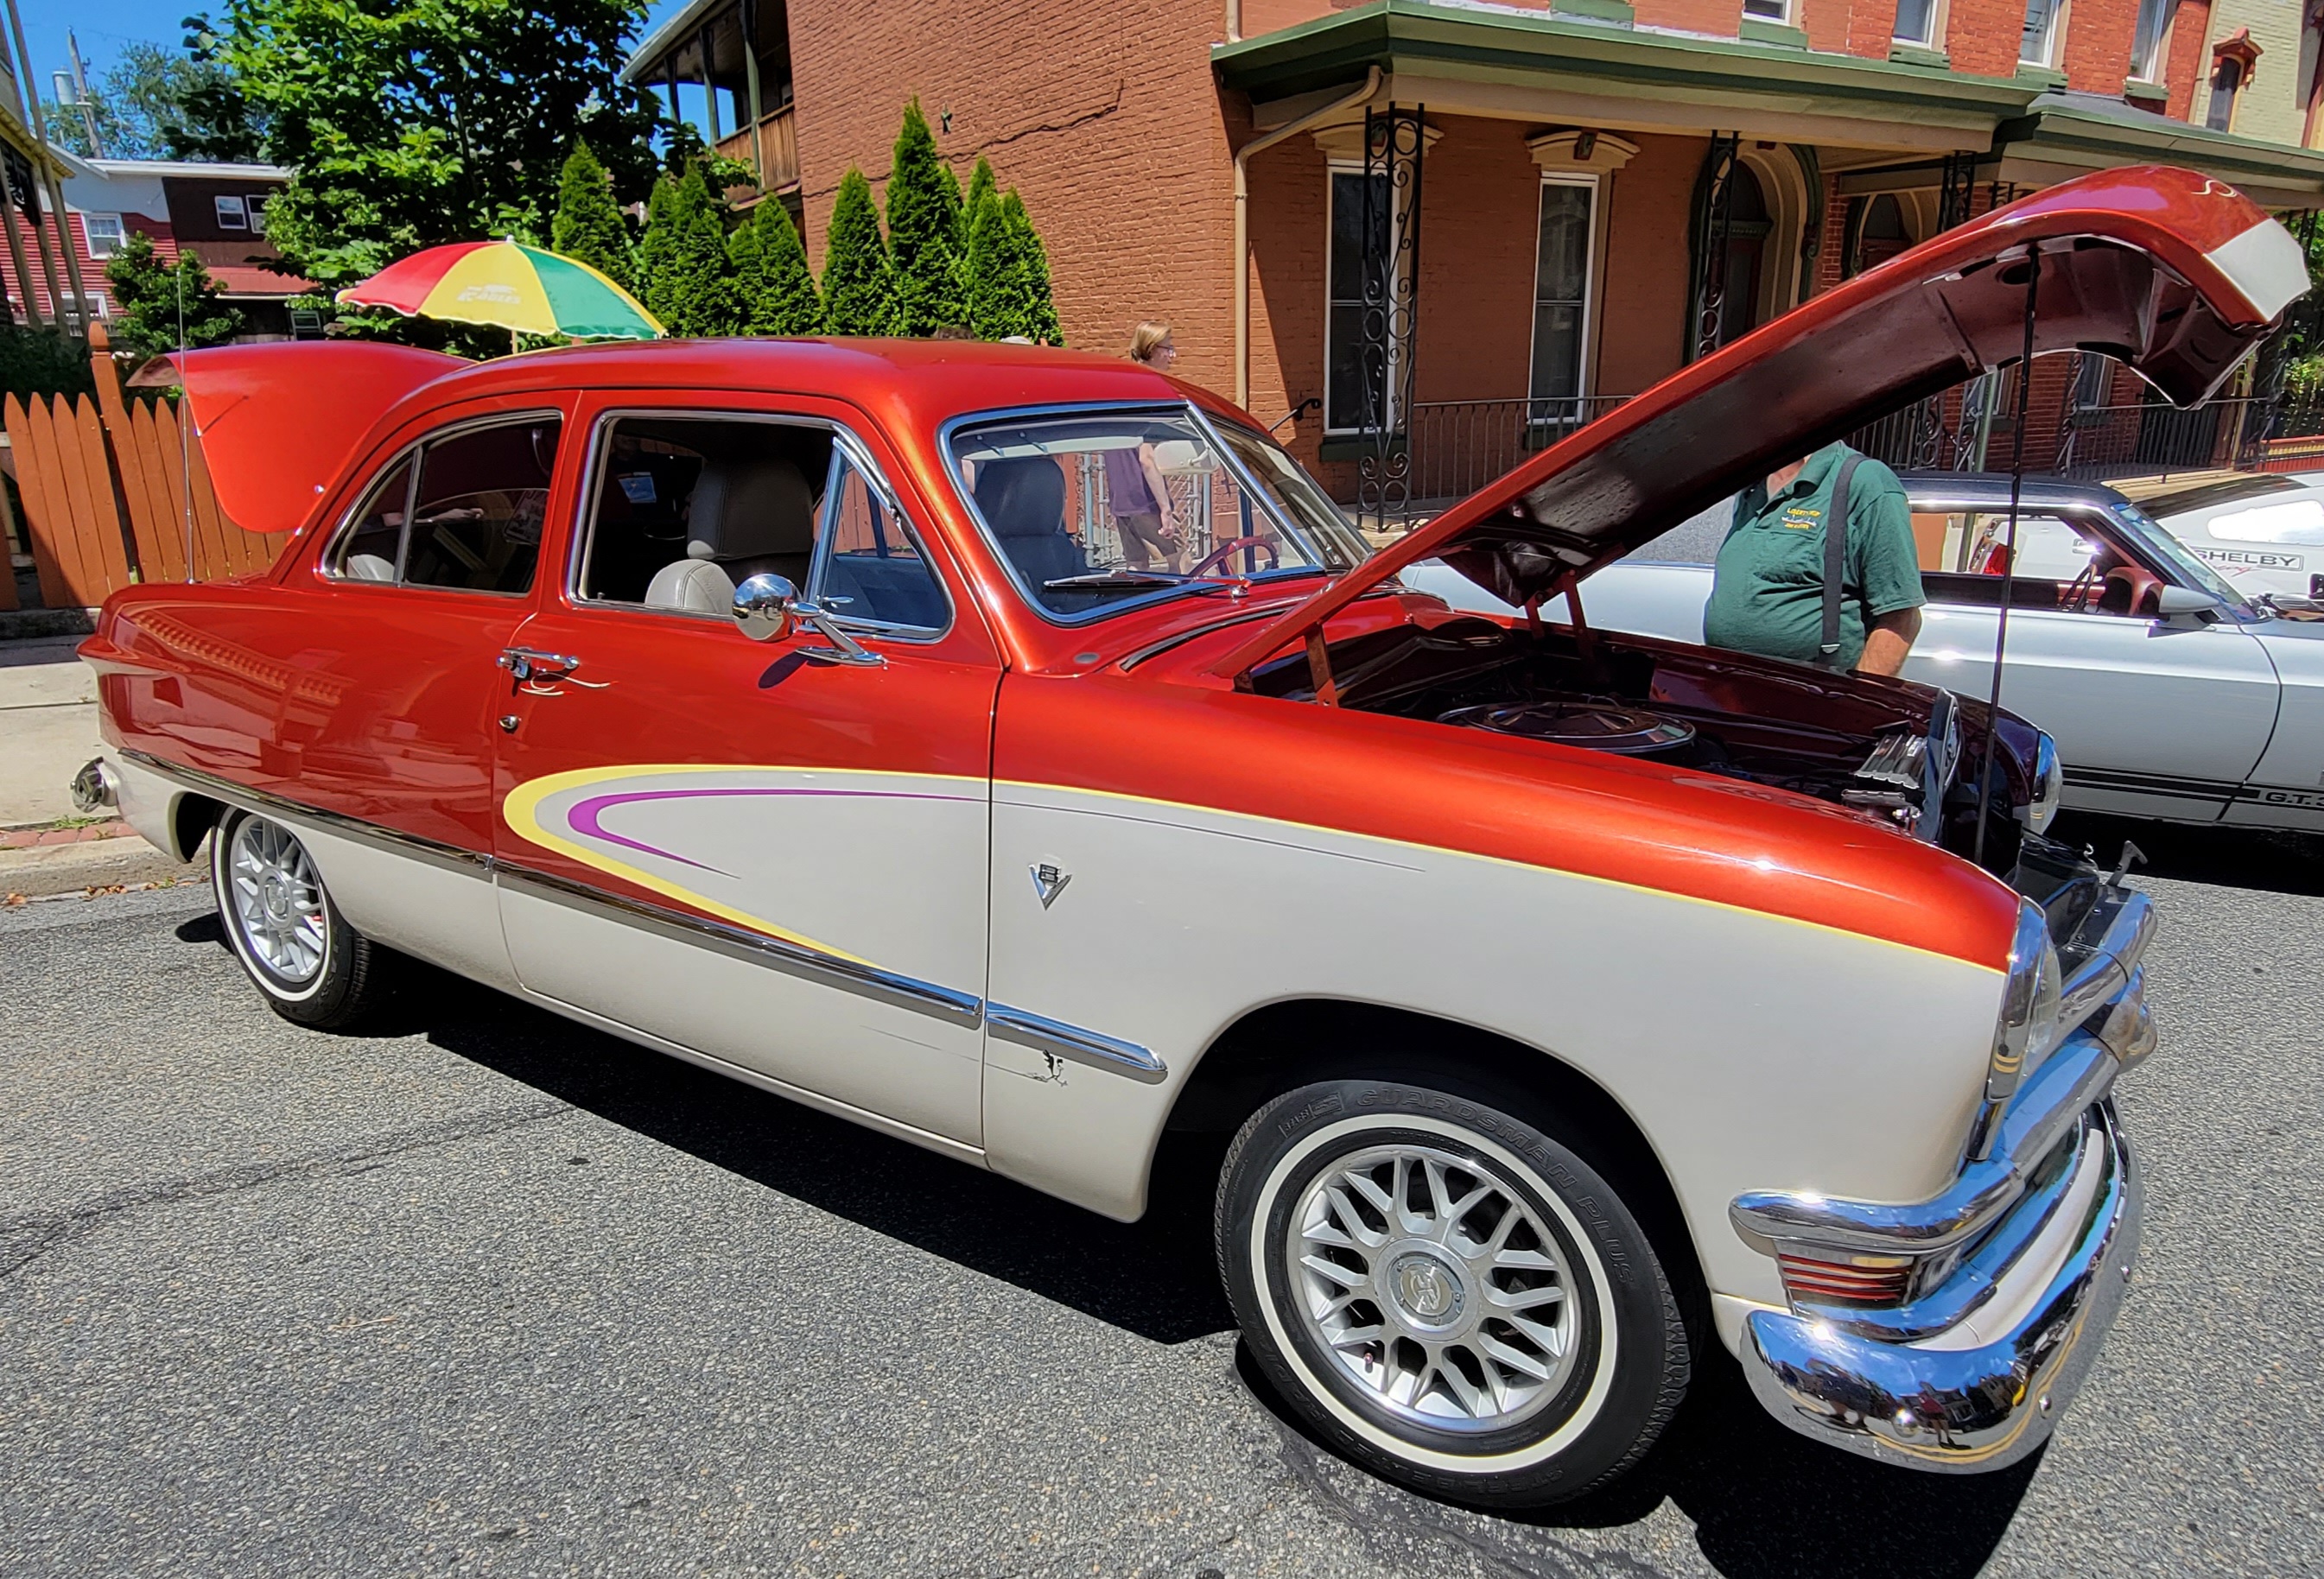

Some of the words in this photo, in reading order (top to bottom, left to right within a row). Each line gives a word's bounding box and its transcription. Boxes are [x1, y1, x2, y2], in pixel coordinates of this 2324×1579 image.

[2195, 549, 2296, 567] SHELBY
[1356, 1088, 1578, 1189] GUARDSMAN
[1577, 1195, 1635, 1284] PLUS
